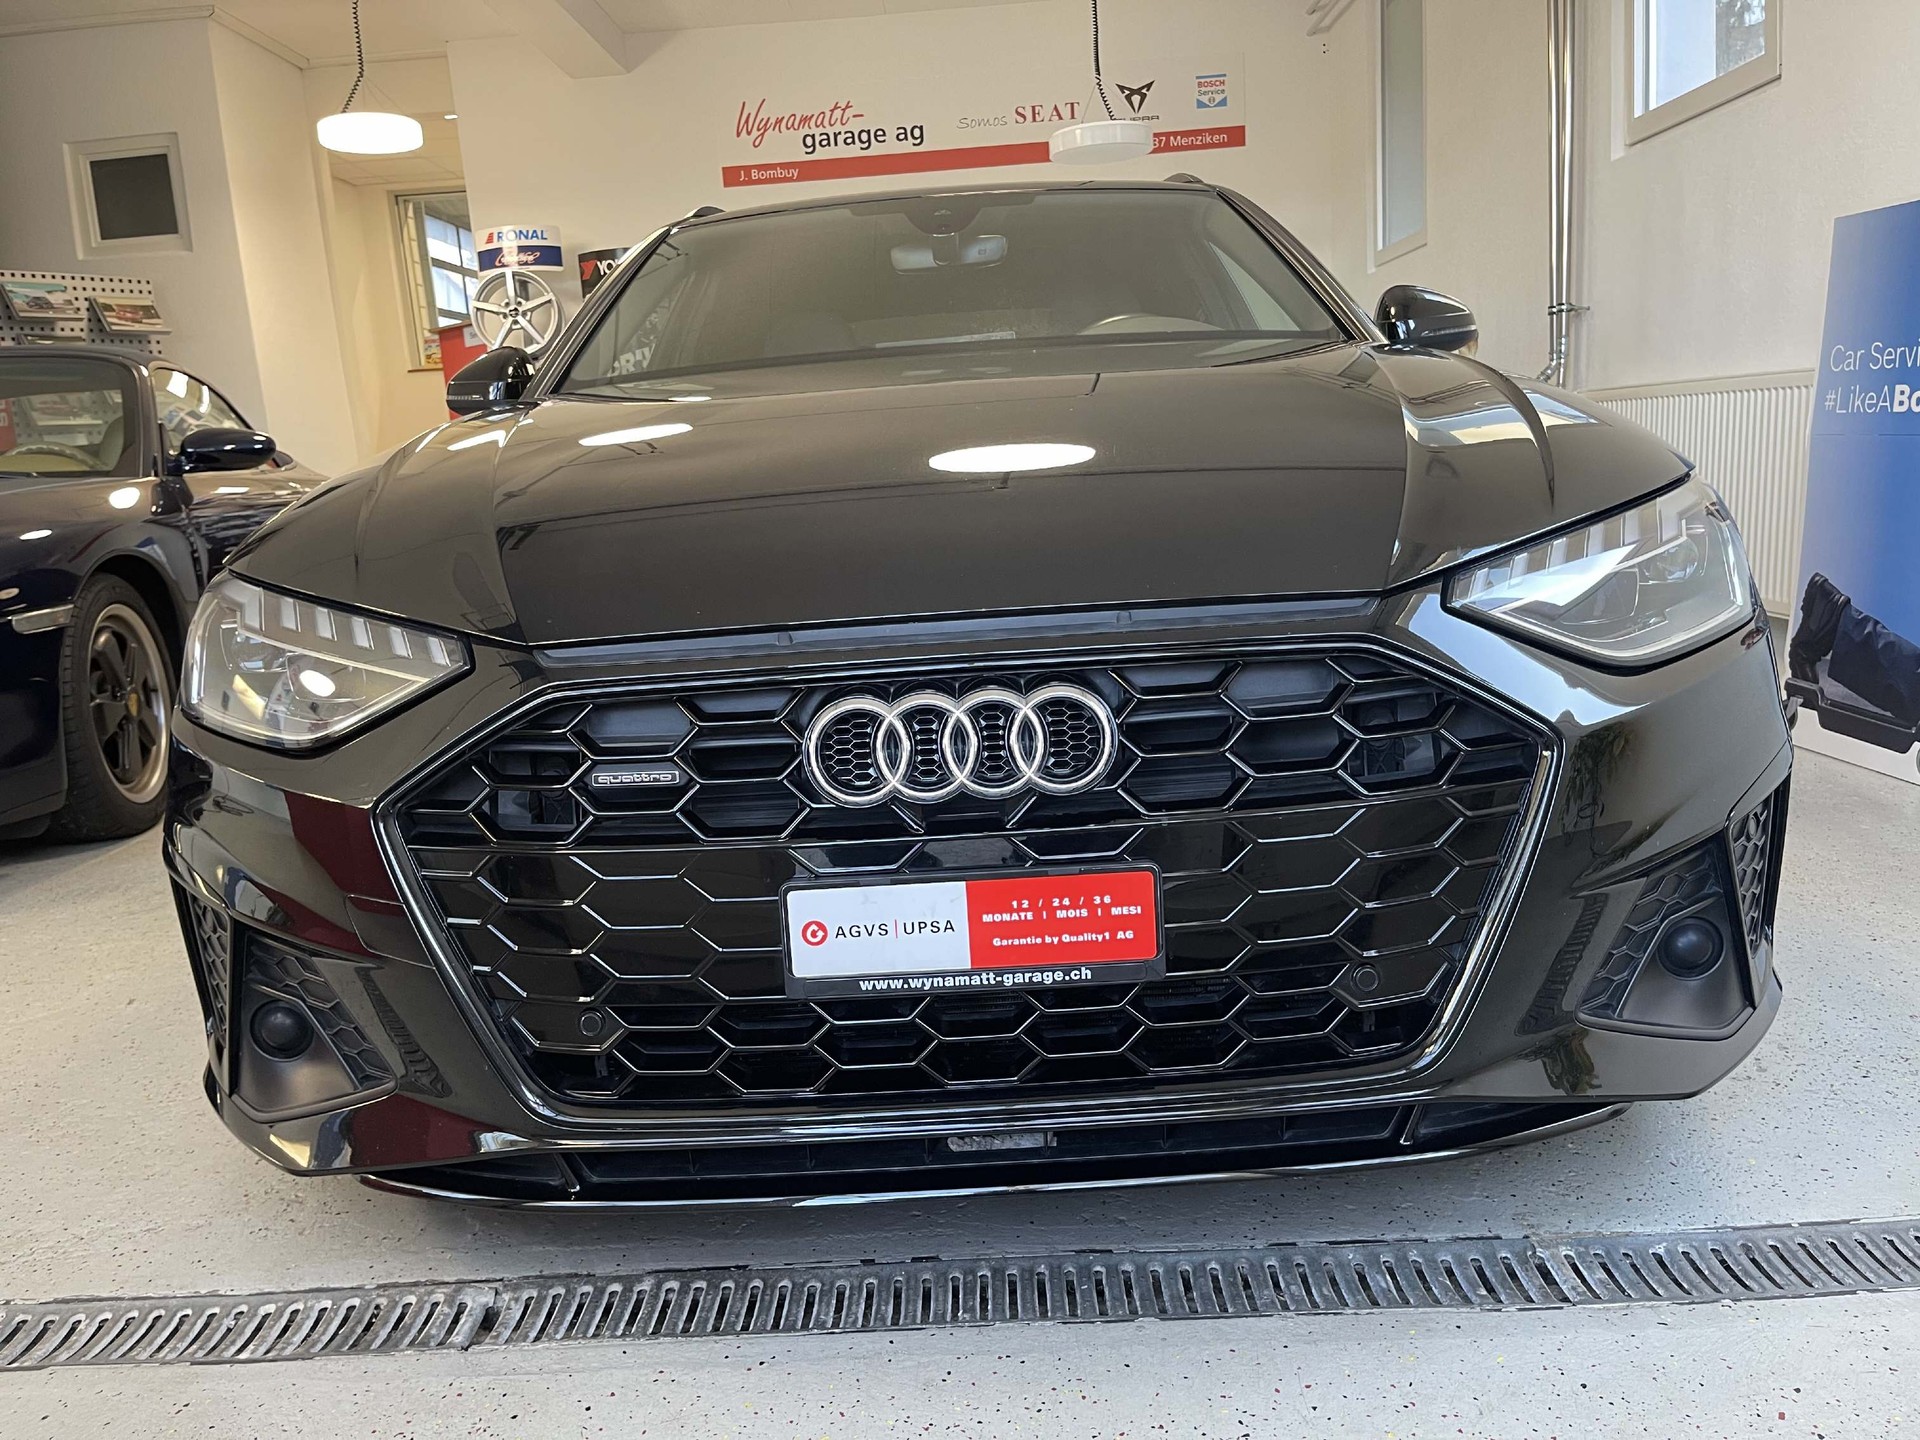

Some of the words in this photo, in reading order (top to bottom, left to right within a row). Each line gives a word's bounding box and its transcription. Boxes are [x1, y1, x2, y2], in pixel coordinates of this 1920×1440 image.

[1197, 79, 1226, 89] BOSCH
[1197, 88, 1226, 97] Service
[736, 98, 864, 149] Wynamatt-
[957, 115, 1008, 130] Somos
[1014, 101, 1080, 125] SEAT
[802, 127, 887, 155] garage
[896, 123, 924, 147] ag
[1169, 131, 1228, 147] Menziken
[739, 170, 748, 182] J.
[751, 167, 799, 181] Bombuy
[496, 229, 548, 242] RONAL
[1830, 344, 1865, 372] Car
[597, 773, 672, 785] quattro
[982, 912, 1034, 922] MONATE
[1056, 909, 1088, 918] MOIS
[1111, 906, 1142, 916] MESI
[835, 923, 889, 939] AGVS
[903, 919, 955, 935] UPSA
[992, 936, 1043, 946] Garantie
[1044, 935, 1060, 945] by
[1062, 931, 1110, 944] Quality1
[1116, 930, 1134, 940] AG
[858, 966, 1092, 991] www.wynamatt-garage.ch
